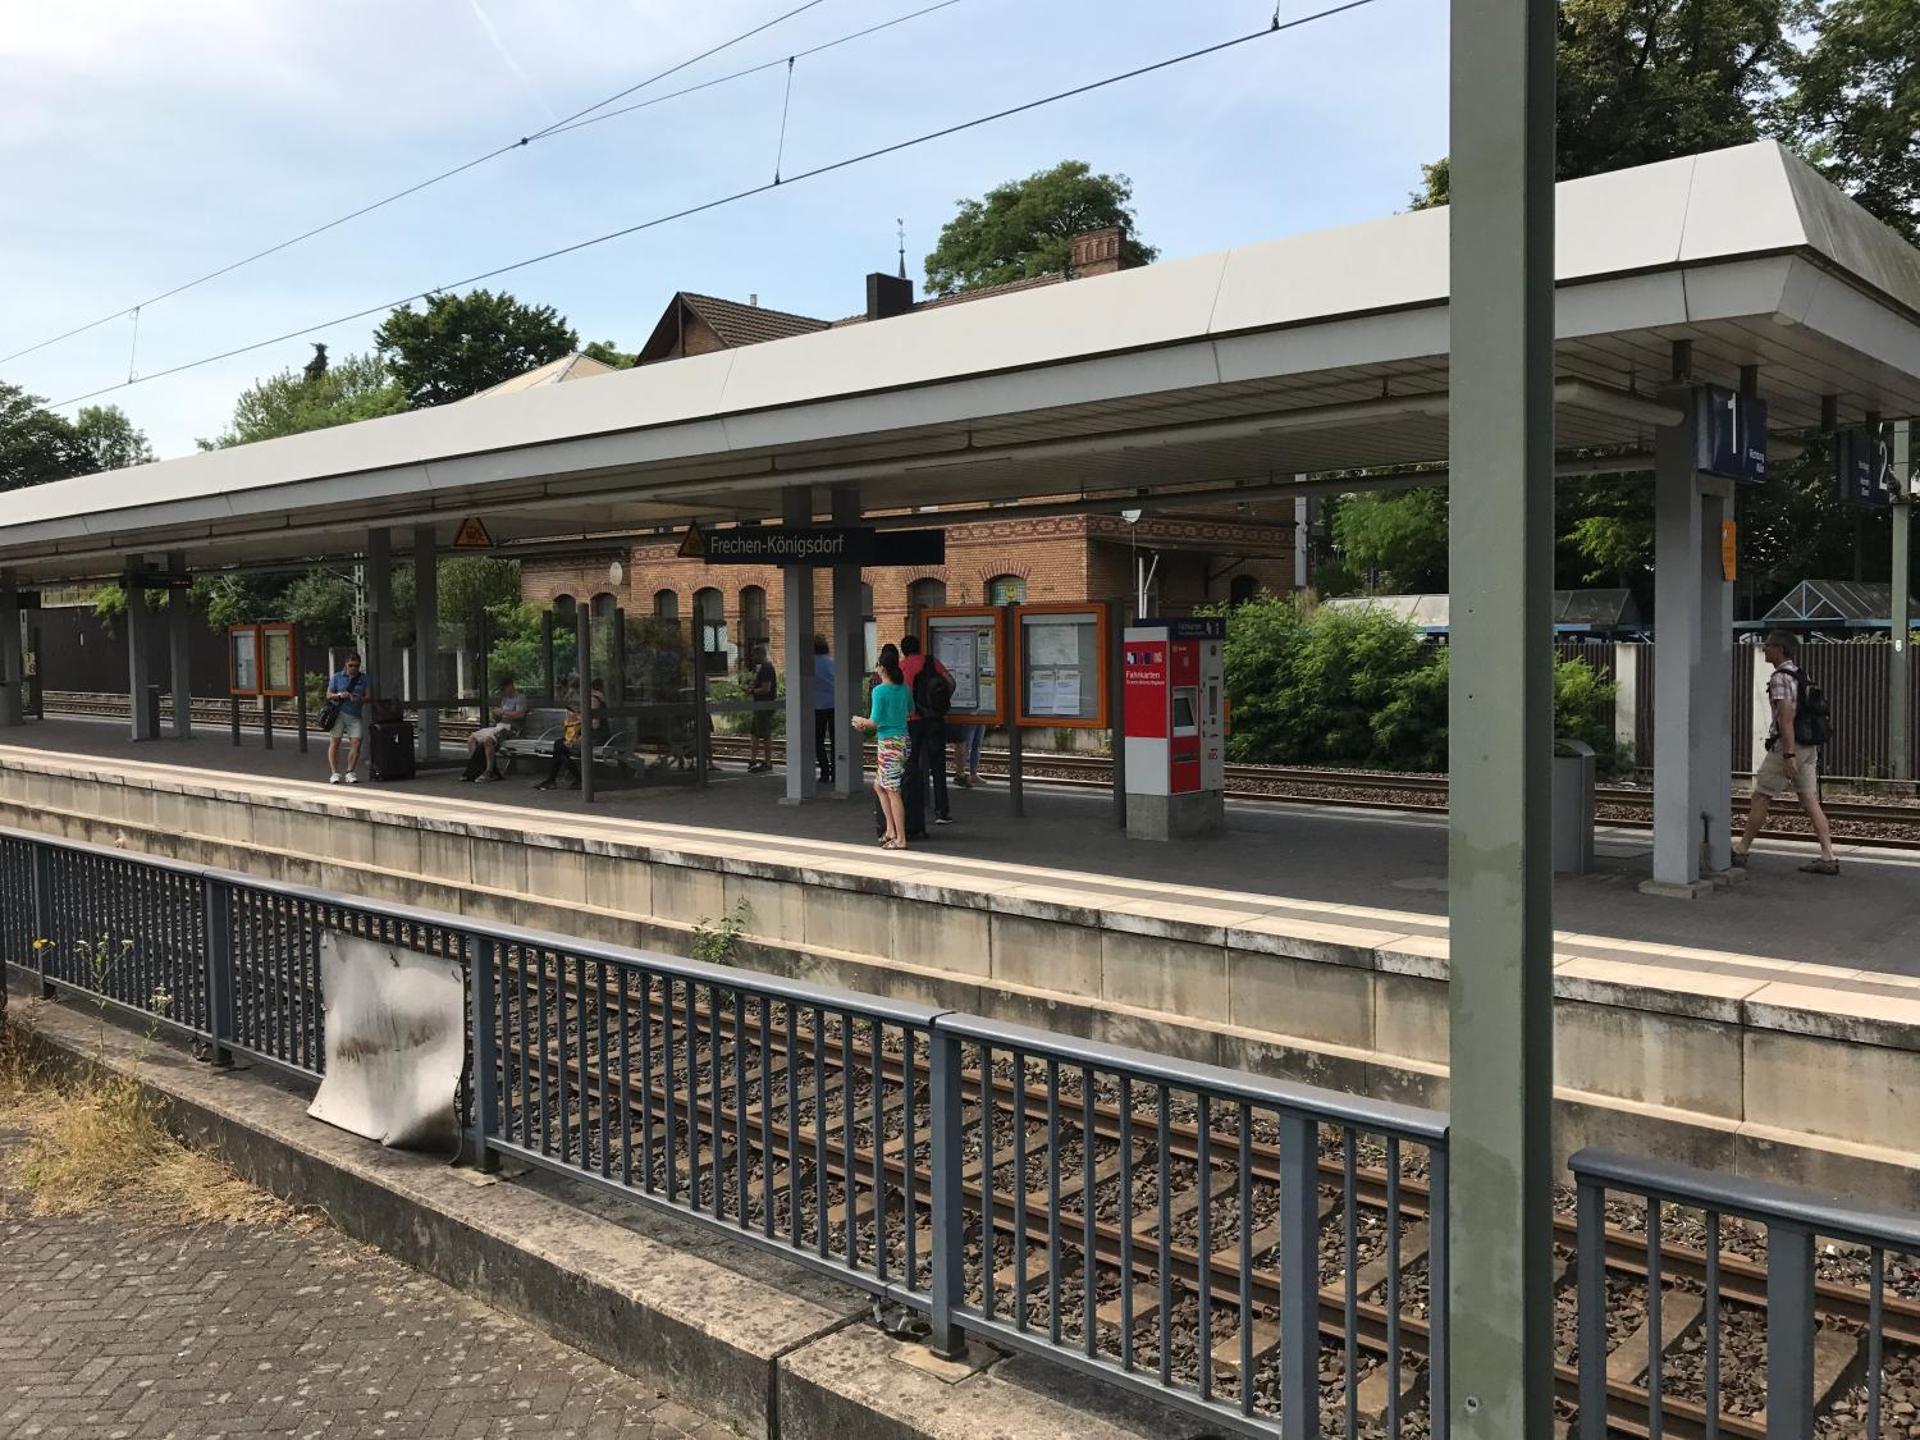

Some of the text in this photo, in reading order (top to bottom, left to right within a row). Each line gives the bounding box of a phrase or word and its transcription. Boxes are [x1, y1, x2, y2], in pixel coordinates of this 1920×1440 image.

[1727, 391, 1737, 455] 1
[1879, 440, 1888, 490] 2
[711, 534, 844, 558] Frechen-Königsdorf
